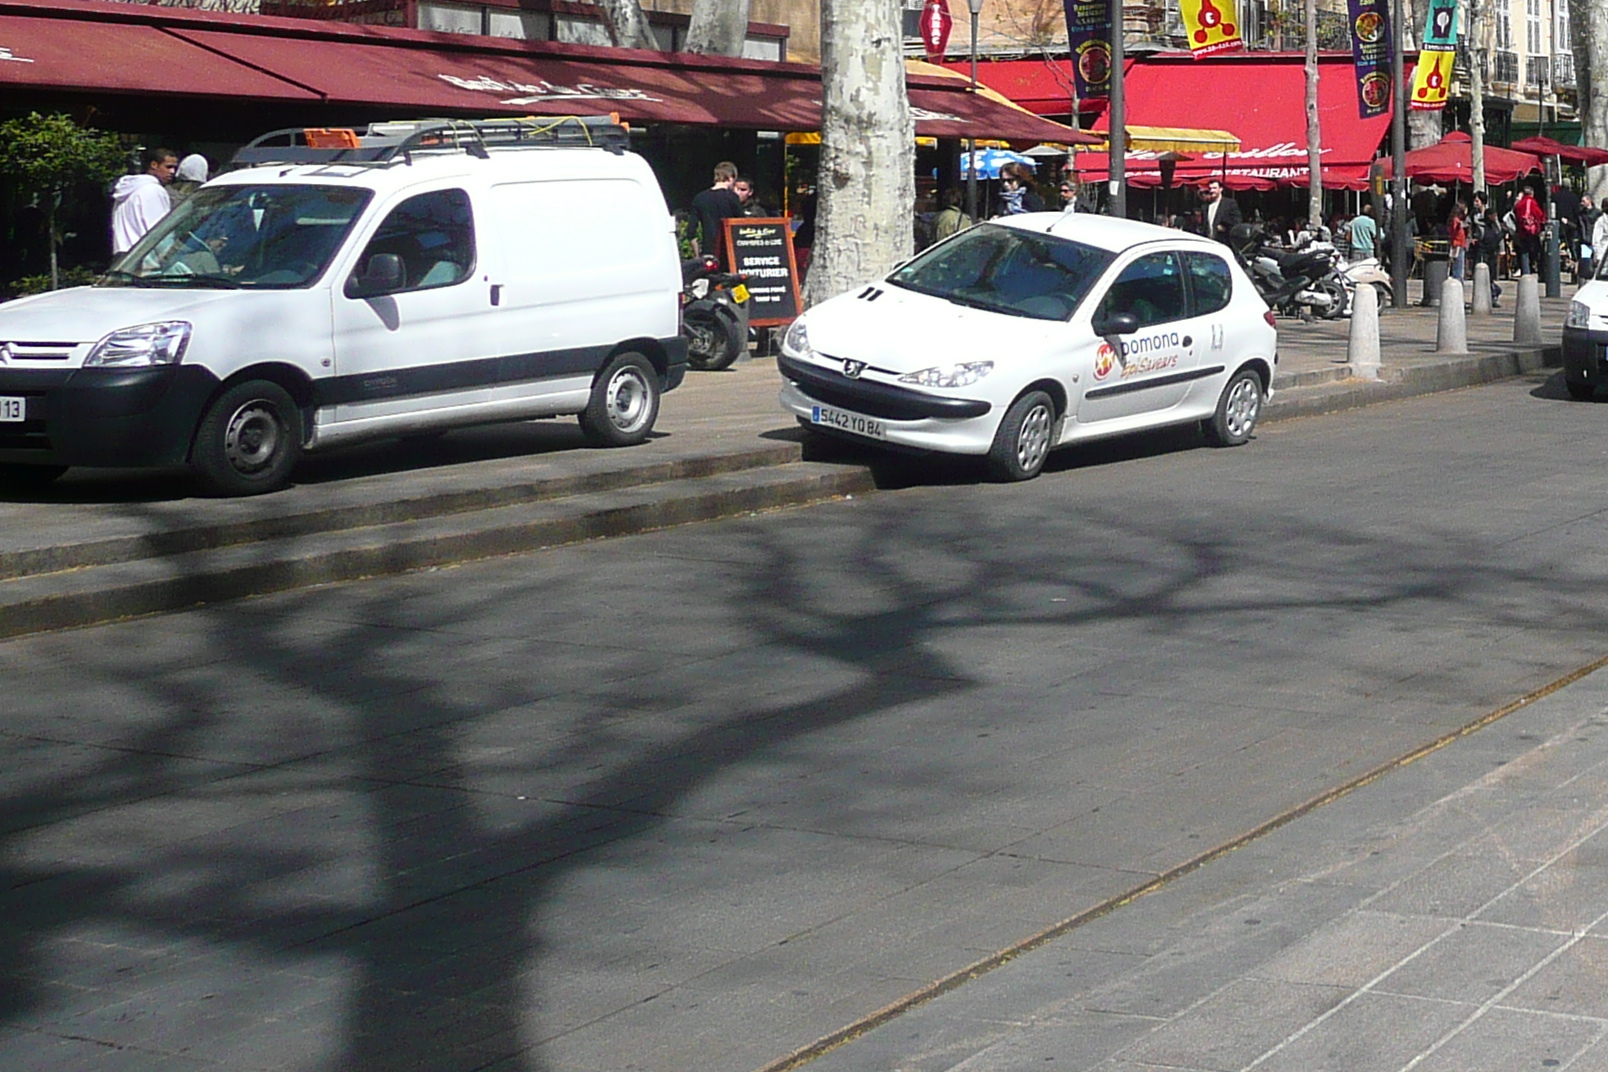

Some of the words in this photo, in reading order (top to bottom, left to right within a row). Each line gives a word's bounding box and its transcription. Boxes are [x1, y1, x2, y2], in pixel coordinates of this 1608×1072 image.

[931, 3, 942, 45] TABAC
[743, 256, 780, 266] SERVICE
[1120, 332, 1180, 356] pomona
[4, 400, 20, 418] 13
[821, 409, 849, 428] 5442
[867, 421, 881, 436] 84
